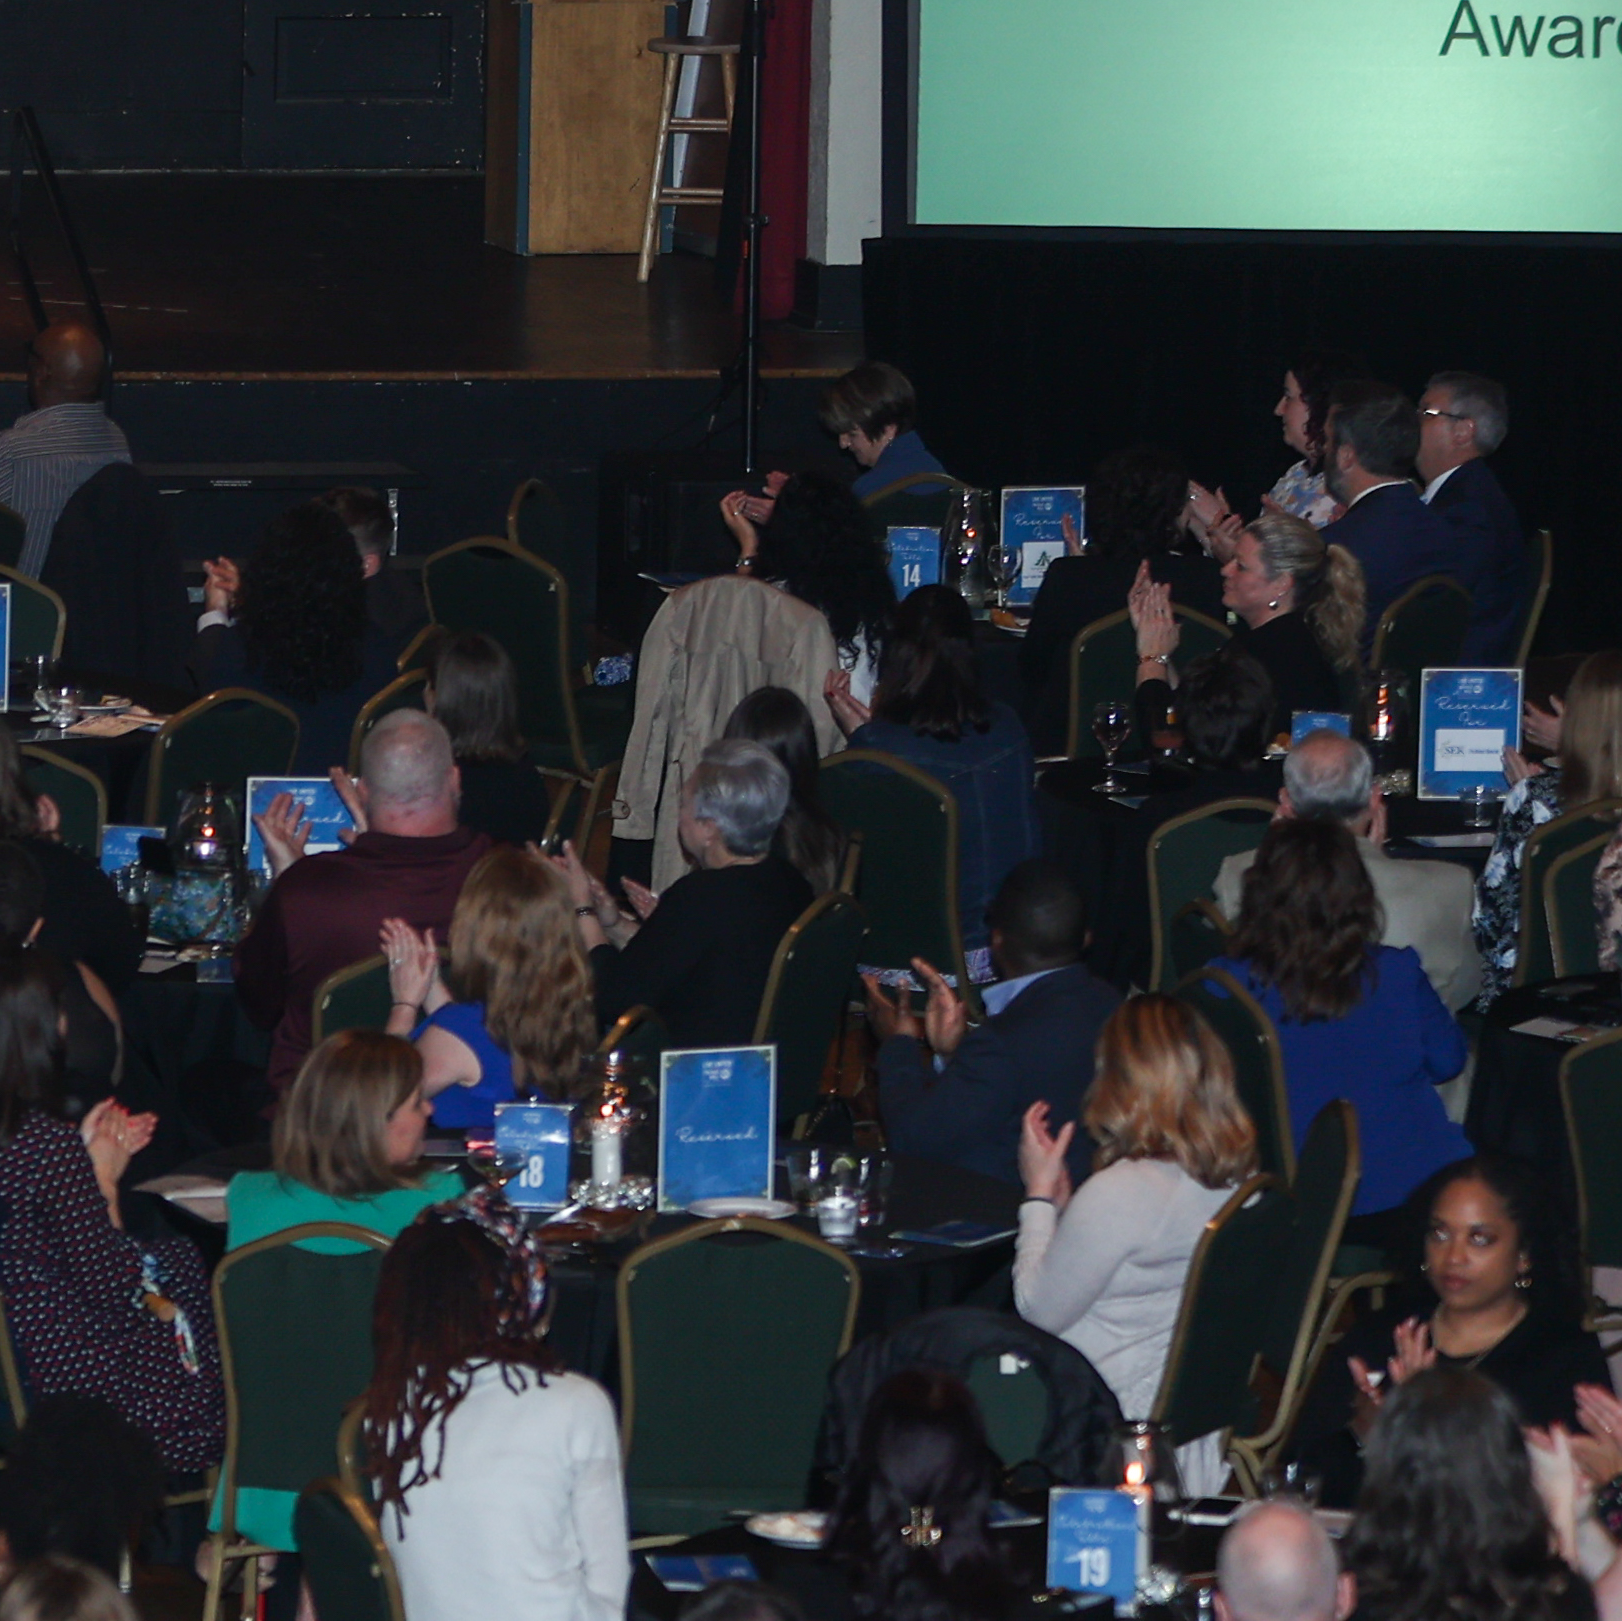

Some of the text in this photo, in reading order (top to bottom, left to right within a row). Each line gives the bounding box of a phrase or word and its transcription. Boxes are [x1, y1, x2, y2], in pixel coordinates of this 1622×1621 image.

[1439, 0, 1622, 59] Awar
[902, 564, 921, 588] 14
[1434, 697, 1512, 710] Reserved
[675, 1126, 758, 1144] Reserved
[1077, 1546, 1110, 1587] 19
